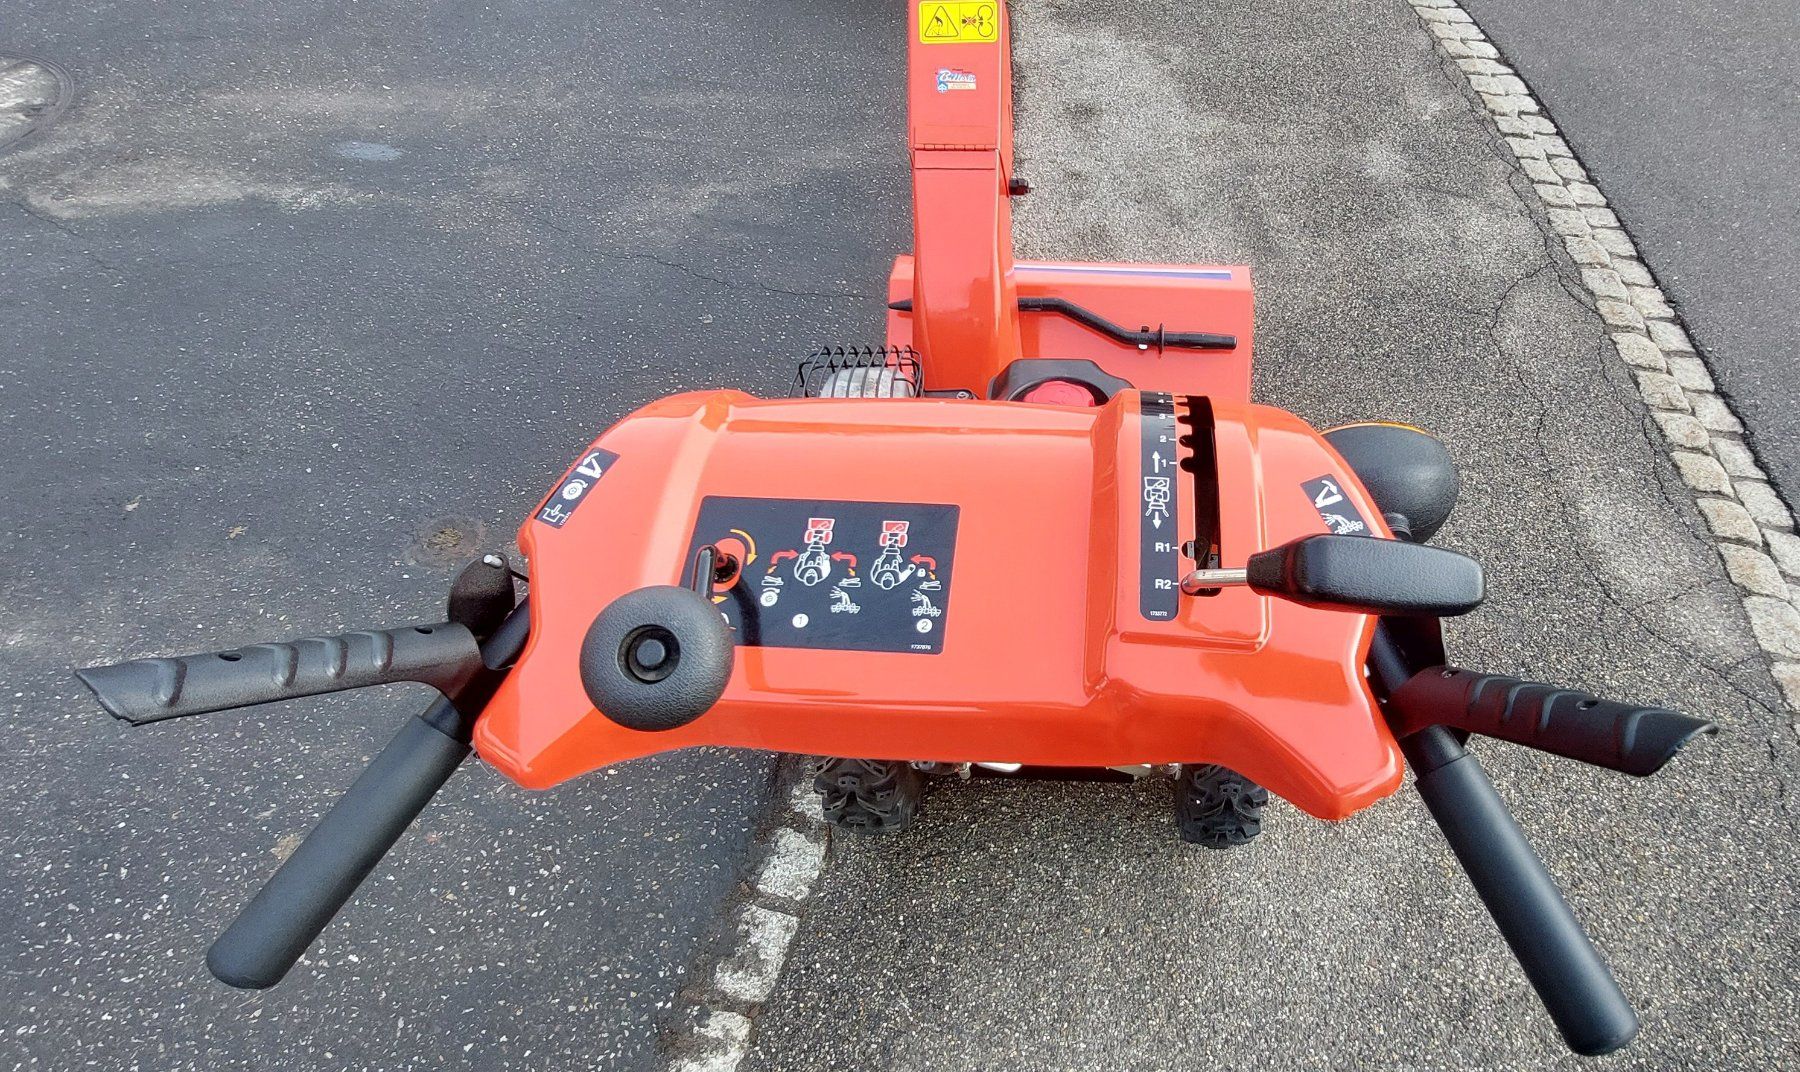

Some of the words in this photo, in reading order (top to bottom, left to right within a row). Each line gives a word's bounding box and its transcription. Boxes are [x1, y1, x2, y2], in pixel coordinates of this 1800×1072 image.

[1160, 435, 1167, 443] 2
[1161, 459, 1167, 468] 1
[1155, 542, 1170, 553] R1
[1155, 579, 1172, 590] R2
[921, 621, 929, 631] 2
